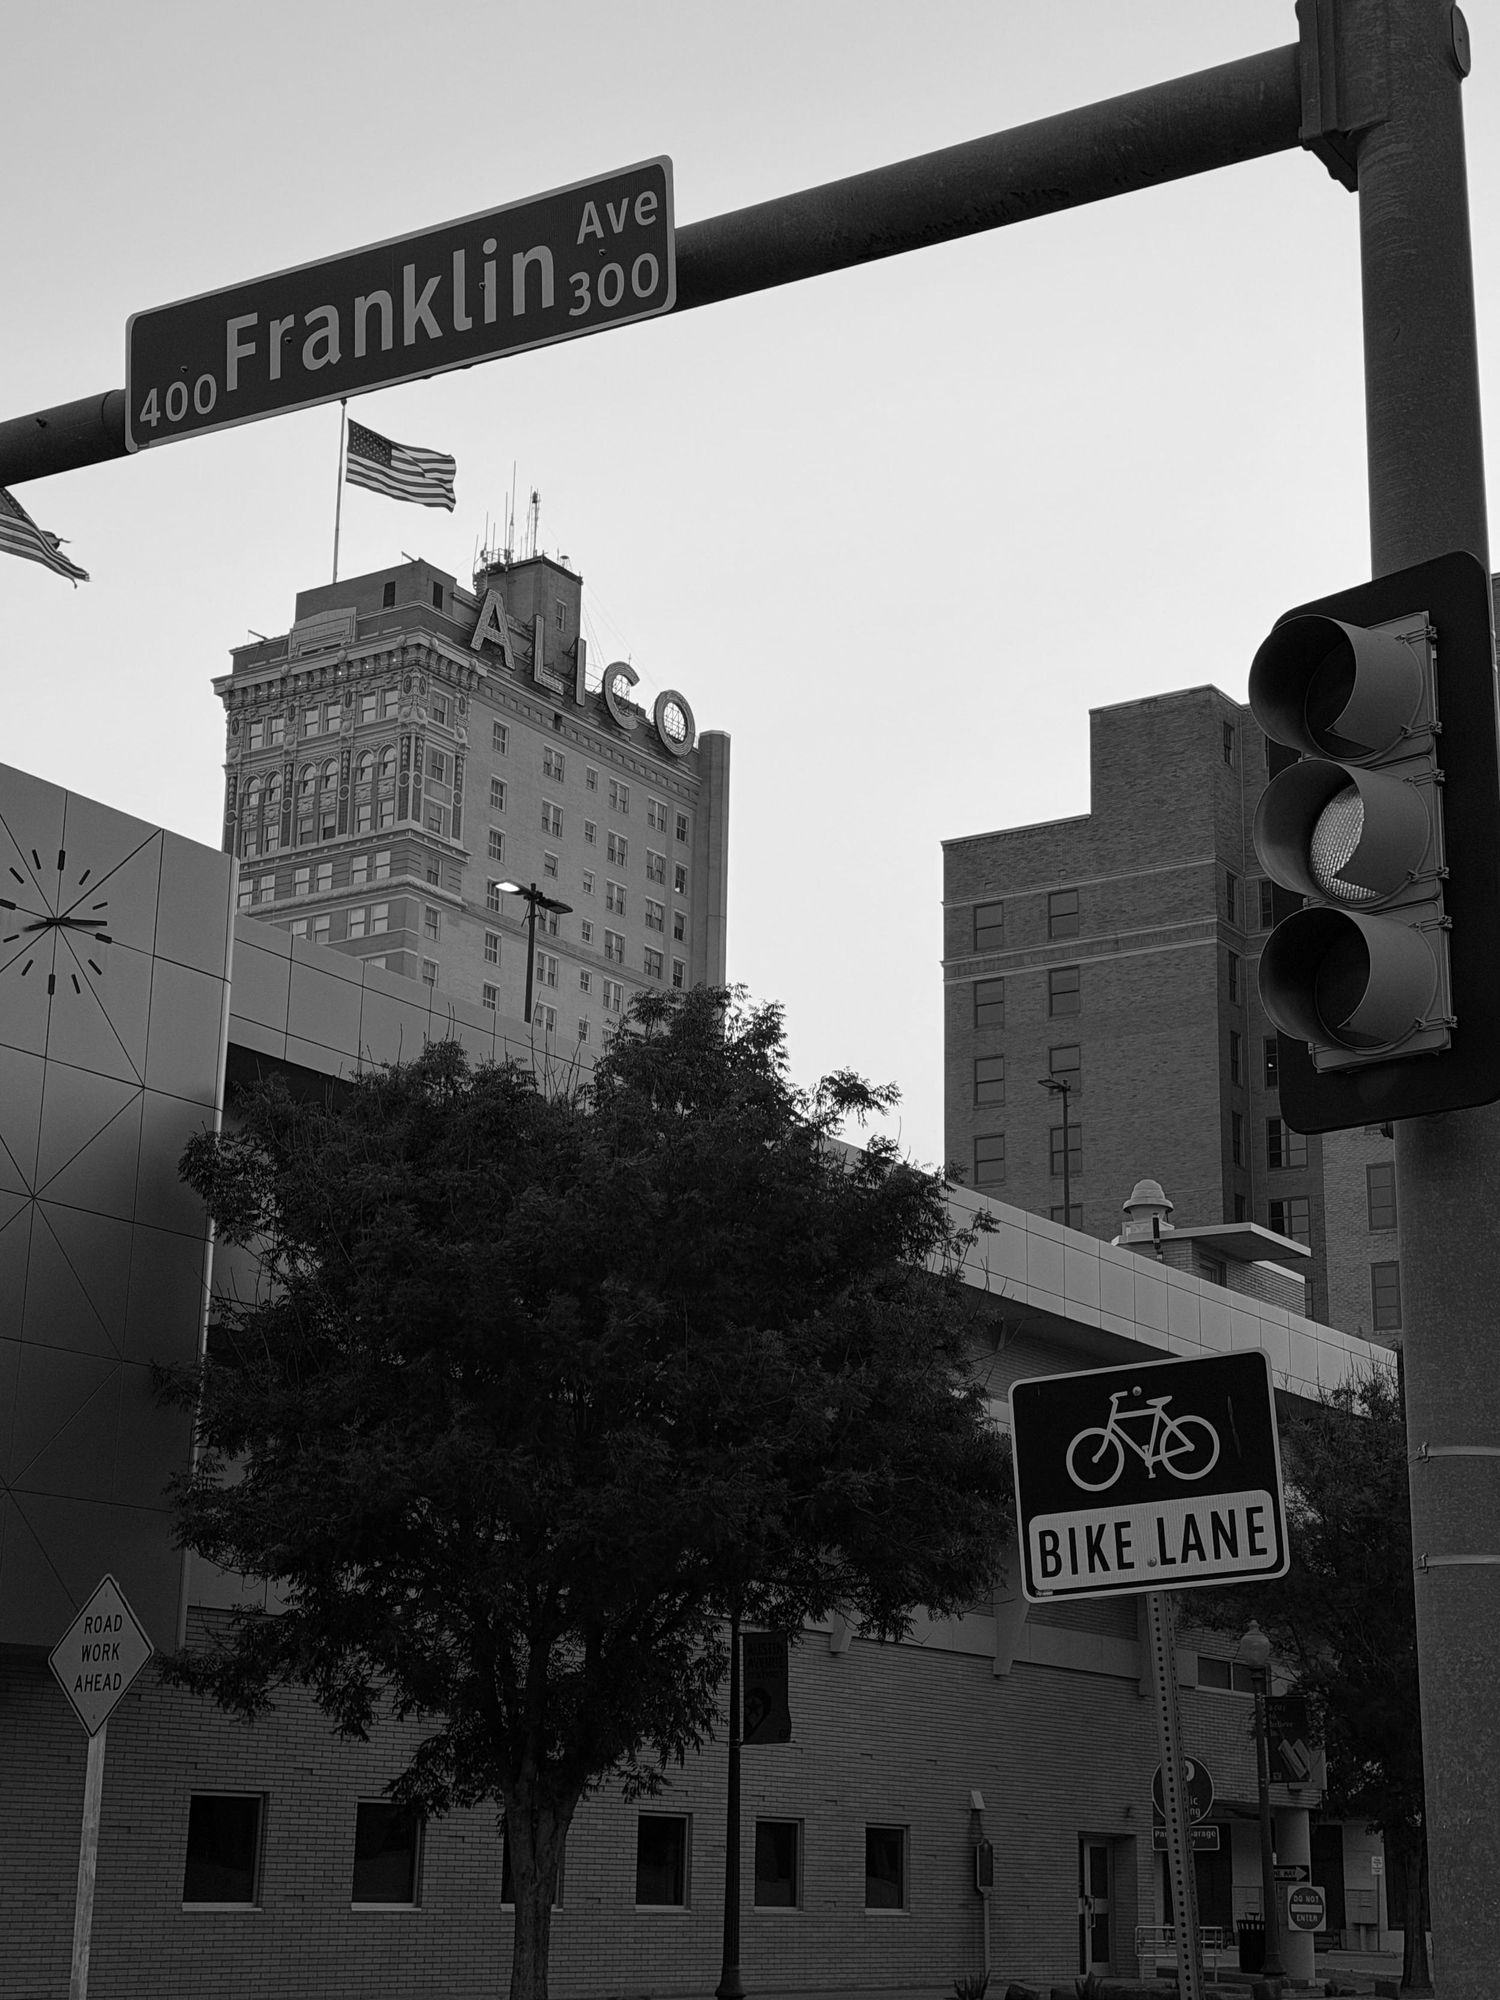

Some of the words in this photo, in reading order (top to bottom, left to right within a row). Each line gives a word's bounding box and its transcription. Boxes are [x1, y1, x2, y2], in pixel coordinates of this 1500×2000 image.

[226, 237, 555, 393] Franklin
[576, 190, 658, 245] Ave
[567, 252, 660, 317] 300
[139, 373, 217, 427] 400
[469, 588, 697, 757] ALICO
[1038, 1519, 1136, 1579] BIKE
[1155, 1504, 1268, 1566] LANE
[84, 1614, 123, 1634] ROAD
[81, 1643, 121, 1662] WORK
[747, 1642, 784, 1655] AUSTIN
[74, 1673, 122, 1692] AHEAD
[1190, 1830, 1217, 1839] arage
[1293, 1895, 1304, 1903] DO
[1306, 1895, 1319, 1903] NOT
[1296, 1913, 1319, 1922] ENTER
